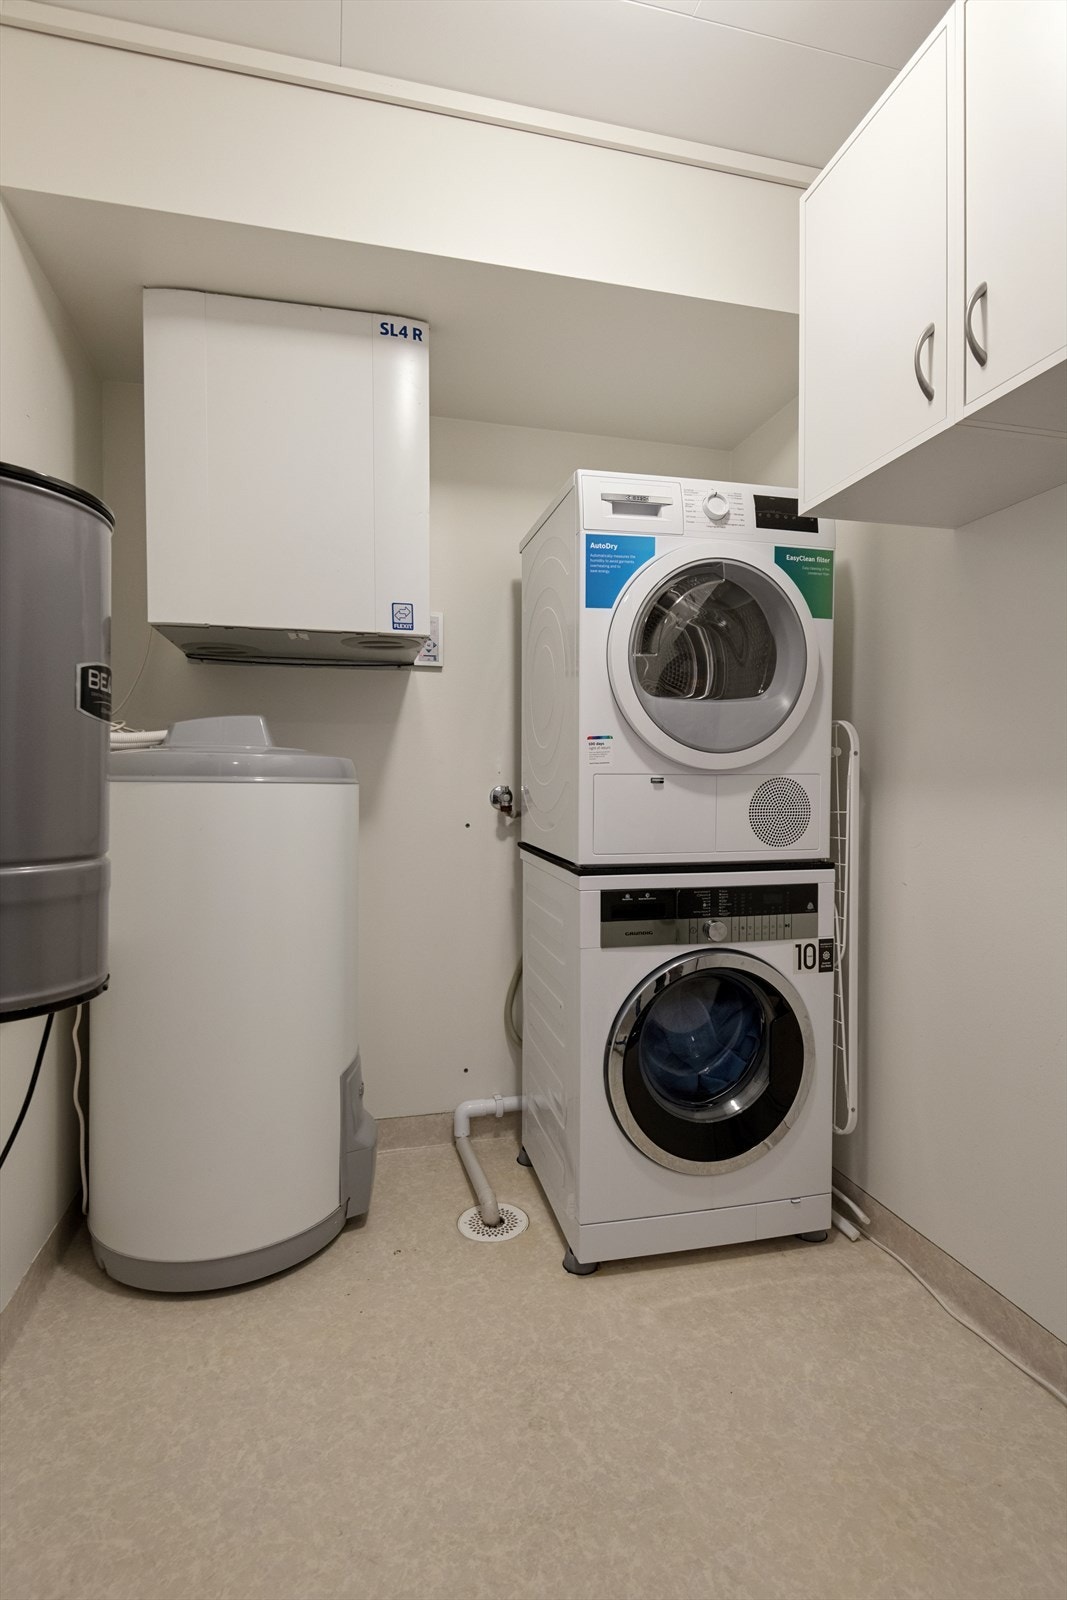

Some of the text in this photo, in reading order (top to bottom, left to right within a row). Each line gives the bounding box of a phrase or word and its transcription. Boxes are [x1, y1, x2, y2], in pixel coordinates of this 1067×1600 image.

[380, 322, 422, 342] SL4 R
[590, 542, 618, 550] AutoDry
[786, 554, 815, 562] EasyClean
[795, 943, 816, 970] 10
